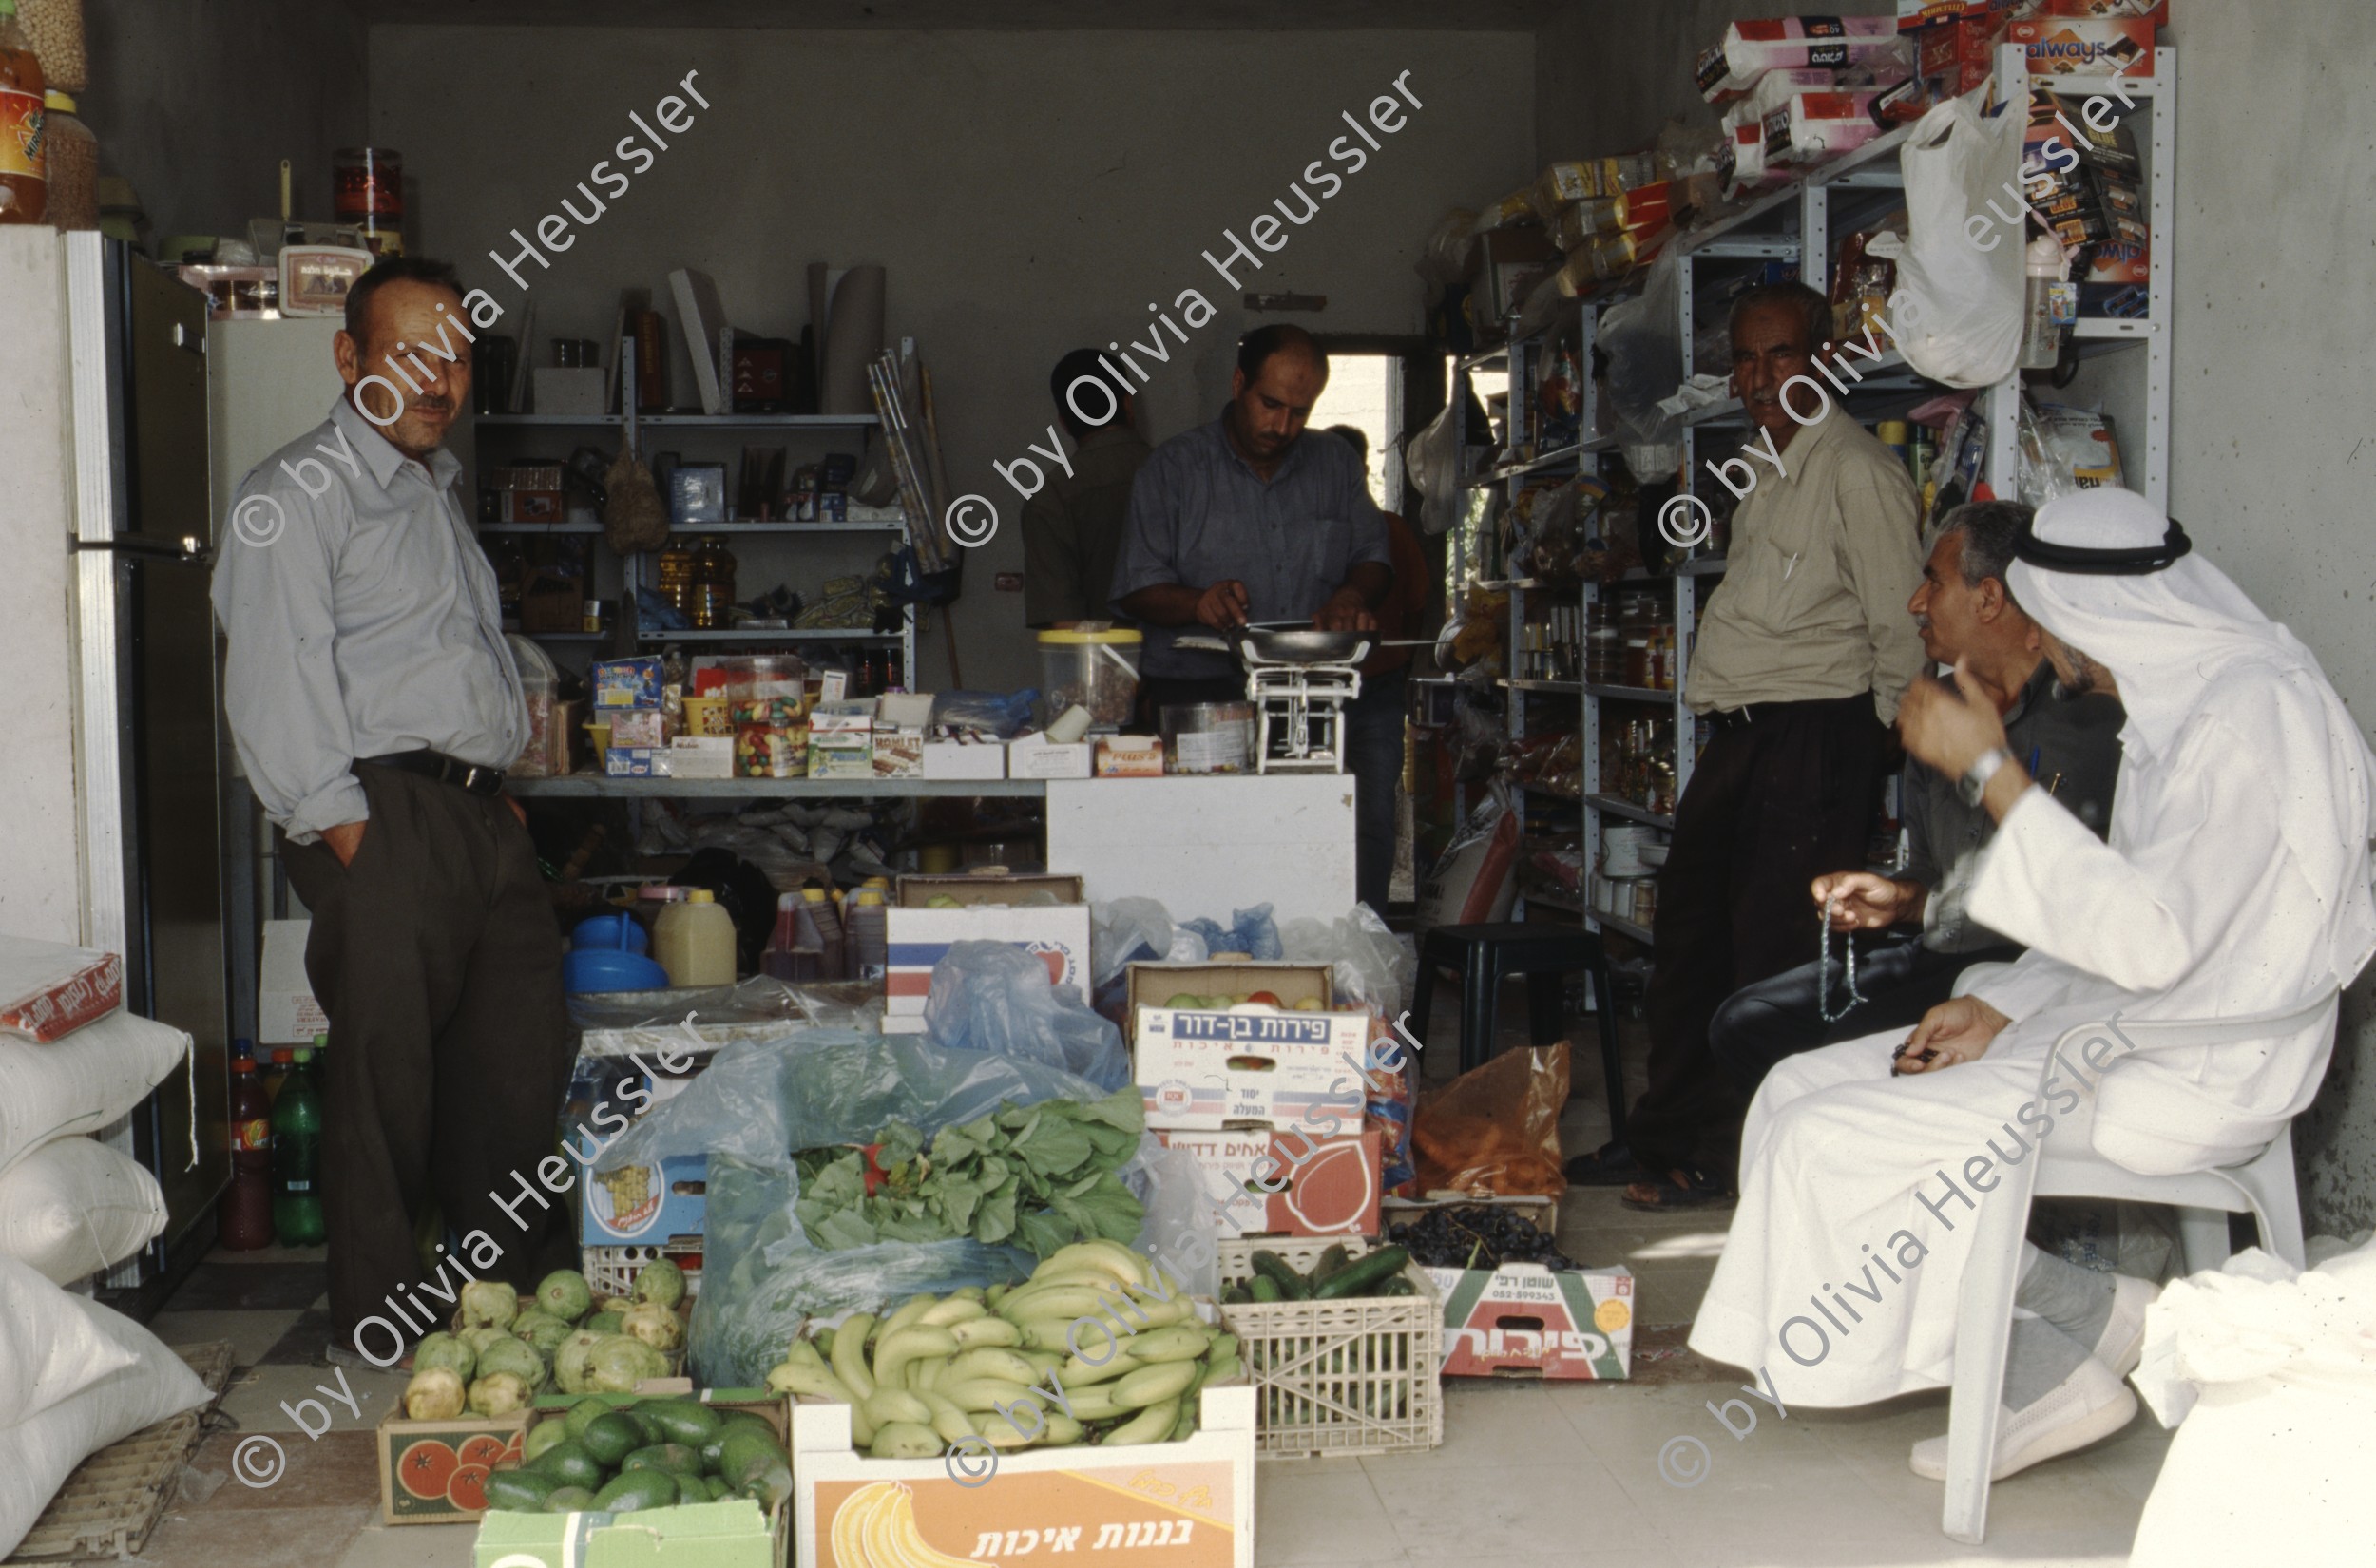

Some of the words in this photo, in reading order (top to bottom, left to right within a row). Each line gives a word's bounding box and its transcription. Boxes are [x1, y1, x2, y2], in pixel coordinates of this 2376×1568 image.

[2025, 36, 2107, 65] always
[24, 114, 45, 162] MIRIN
[1178, 1014, 1253, 1039] בן-דור
[1260, 1017, 1327, 1040] פירות
[1172, 1040, 1234, 1052] איכות
[1270, 1044, 1330, 1056] פירות
[1240, 1088, 1260, 1100] יסוד
[1233, 1103, 1266, 1117] המעלה
[1224, 1142, 1267, 1157] אחים
[1495, 1275, 1519, 1287] רפי
[1523, 1276, 1555, 1288] שומן
[1492, 1290, 1555, 1301] 052-599343
[1443, 1327, 1608, 1361] פירות
[970, 1526, 1082, 1558] איכות
[1092, 1519, 1195, 1552] בננות
